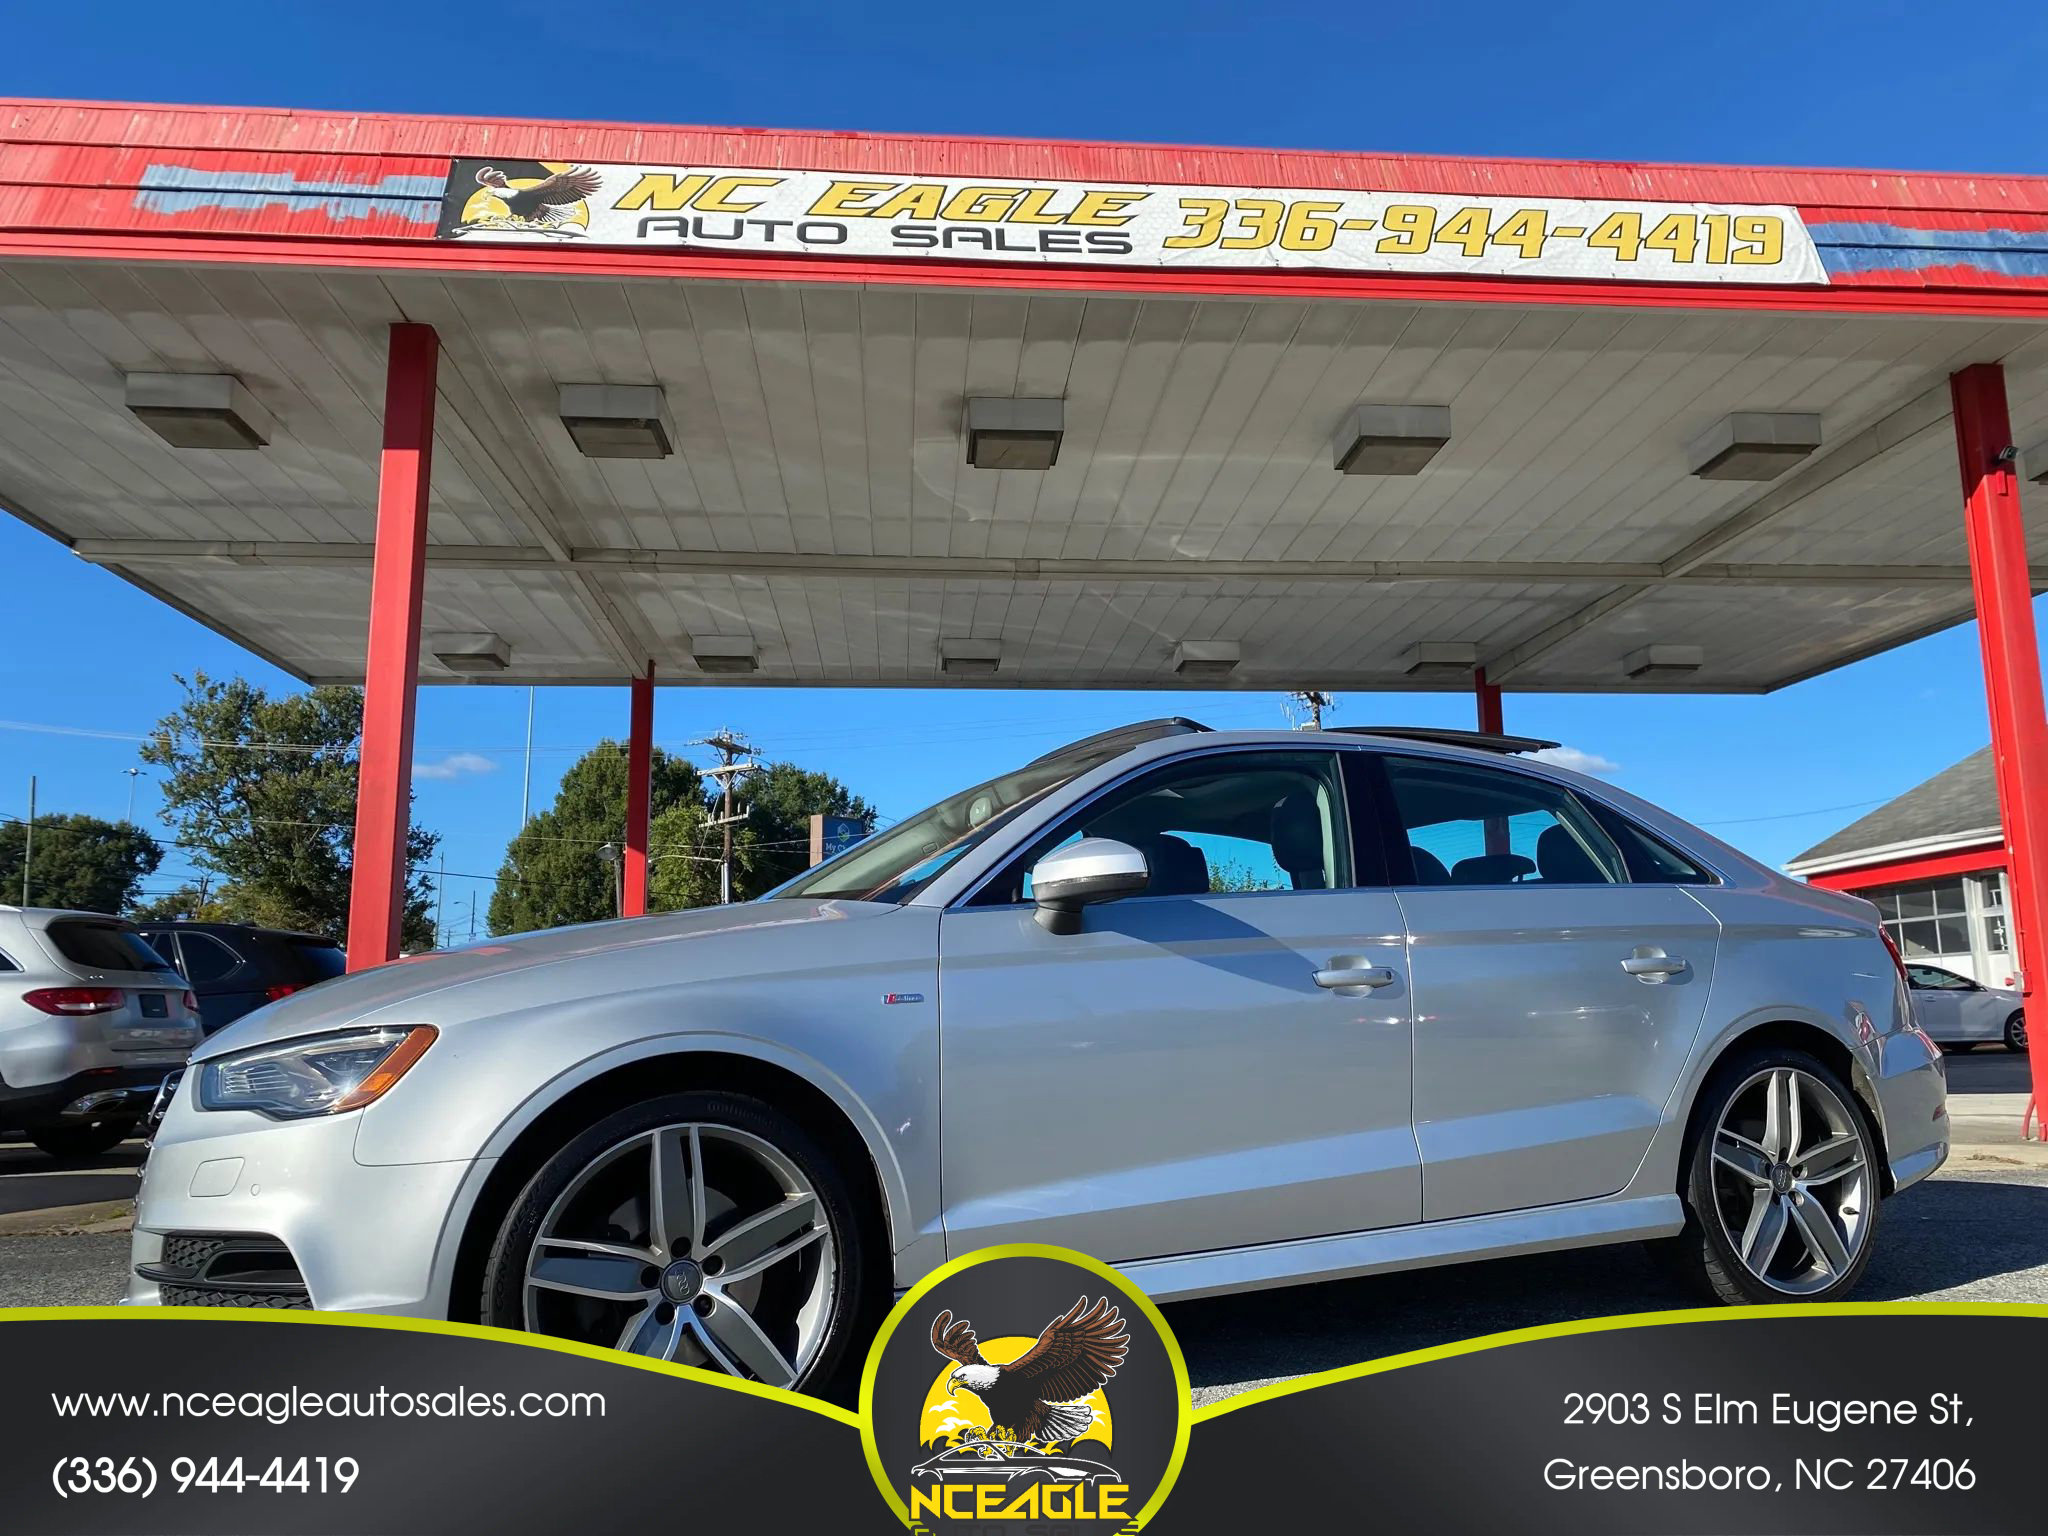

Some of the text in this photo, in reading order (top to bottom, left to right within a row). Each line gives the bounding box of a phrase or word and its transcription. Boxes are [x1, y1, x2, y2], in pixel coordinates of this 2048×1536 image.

[610, 173, 1155, 226] NC EAGLE
[637, 216, 1132, 254] AUTO SALES
[1162, 198, 1784, 265] 336-944-4419
[826, 843, 836, 853] My
